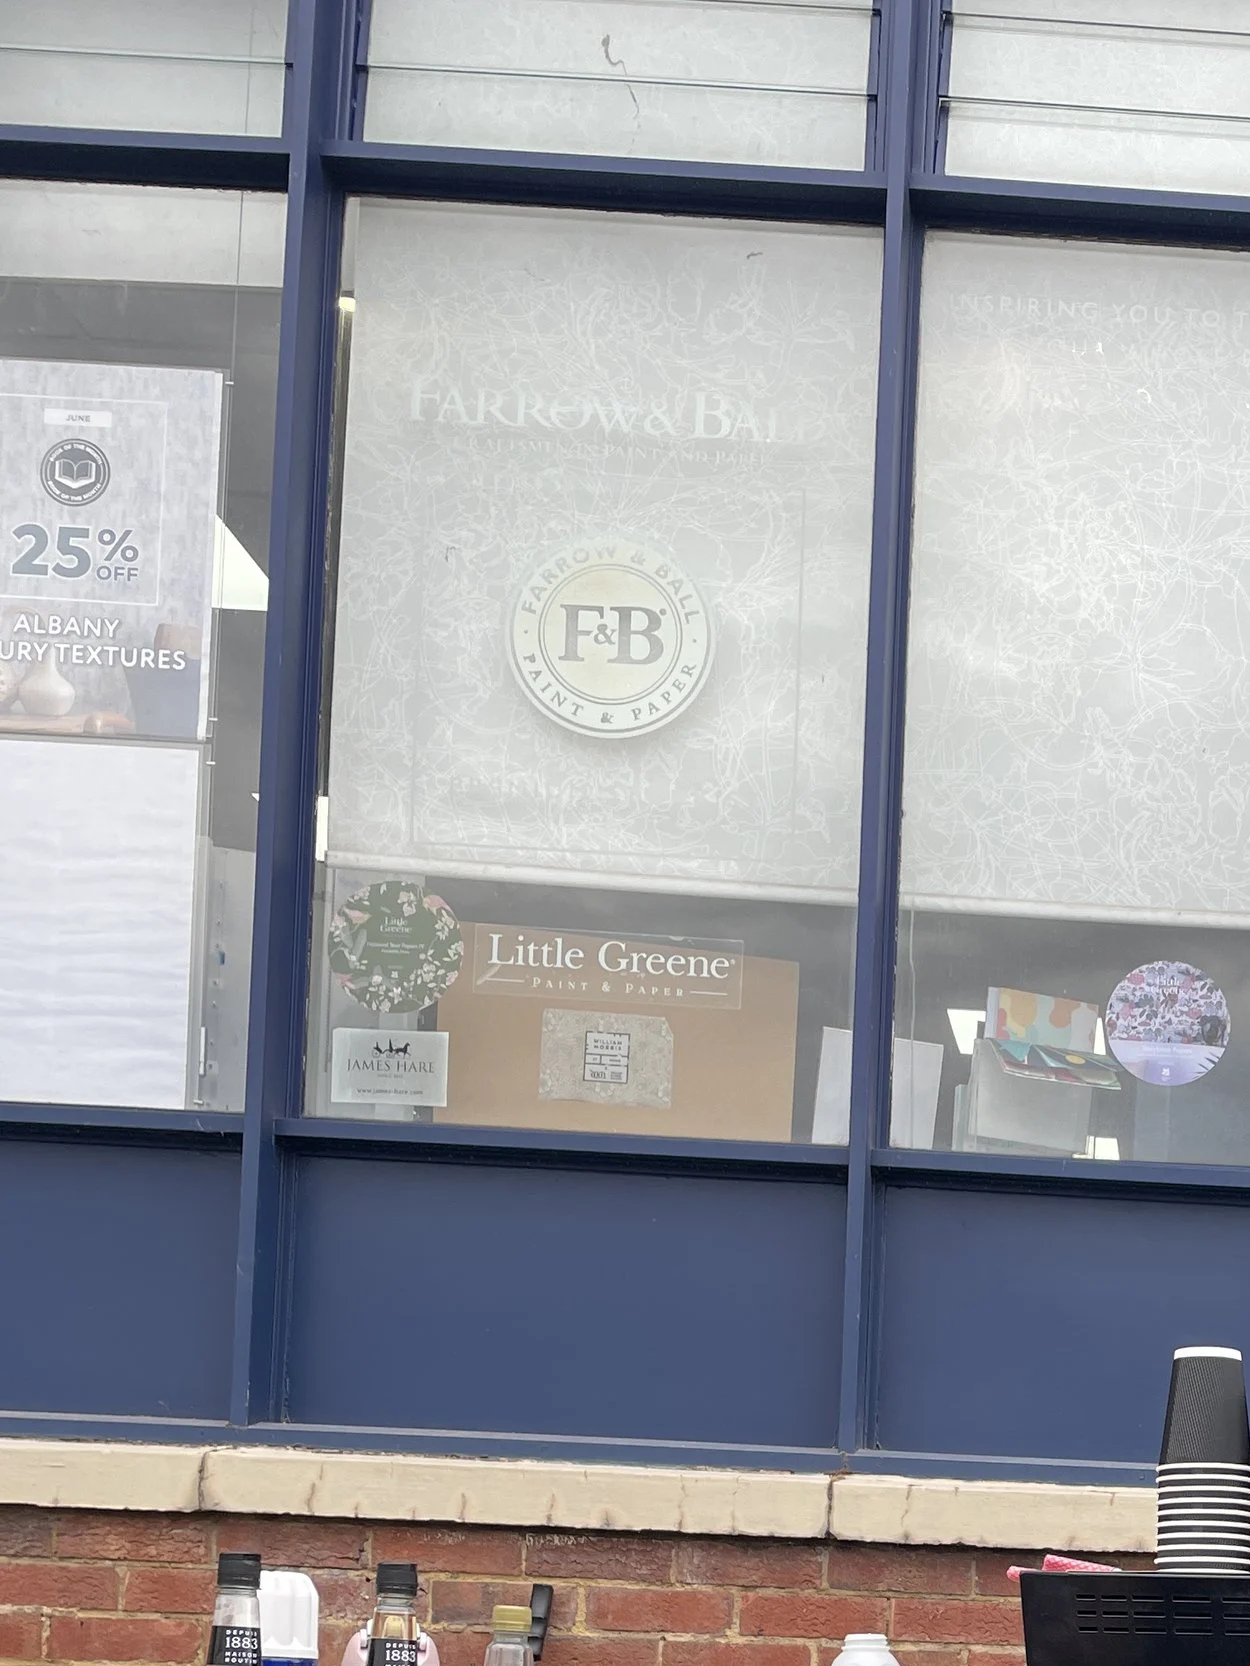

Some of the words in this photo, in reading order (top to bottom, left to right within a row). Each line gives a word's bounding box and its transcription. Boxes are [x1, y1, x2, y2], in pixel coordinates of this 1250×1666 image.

[1112, 303, 1172, 324] YOU
[1184, 308, 1220, 329] TO
[65, 414, 91, 422] JUNE
[409, 386, 640, 436] FARROW
[643, 400, 679, 438] &
[96, 566, 139, 582] OFF
[521, 546, 618, 616] FARROW
[629, 549, 646, 566] &
[656, 562, 701, 624] BALL
[13, 613, 121, 638] ALBANY
[557, 603, 667, 665] F&B
[55, 643, 186, 671] TEXTURES
[522, 651, 585, 719] PAINT
[600, 711, 614, 724] &
[631, 661, 698, 721] PAPER
[487, 933, 584, 970] Little
[532, 977, 588, 992] PAINT
[602, 981, 611, 992] &
[625, 983, 685, 998] PAPER
[347, 1058, 391, 1074] JAMES
[396, 1059, 435, 1075] HARE
[225, 1637, 259, 1650] 1883
[385, 1642, 416, 1650] DEPUIS
[385, 1650, 416, 1662] 1883
